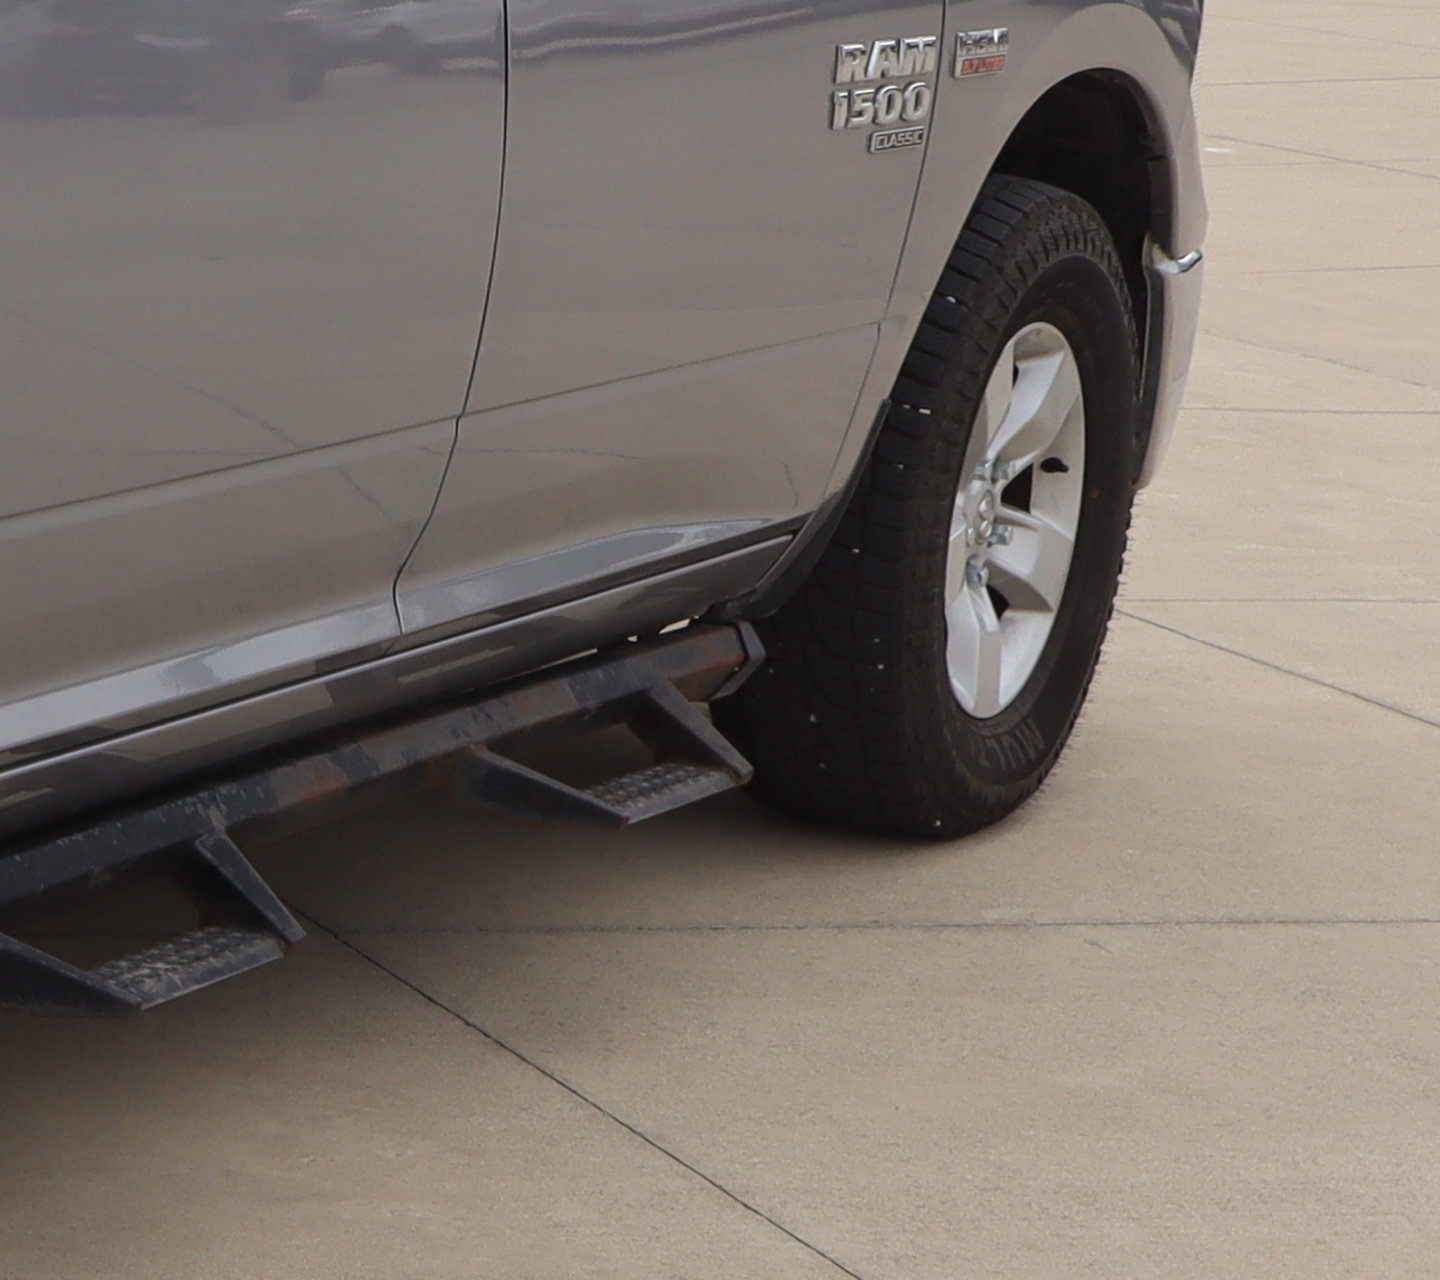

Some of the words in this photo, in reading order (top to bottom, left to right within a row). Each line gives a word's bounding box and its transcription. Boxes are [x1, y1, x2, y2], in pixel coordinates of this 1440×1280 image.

[836, 35, 937, 84] RAM
[830, 81, 930, 130] 1500
[875, 130, 924, 150] CLASSIC
